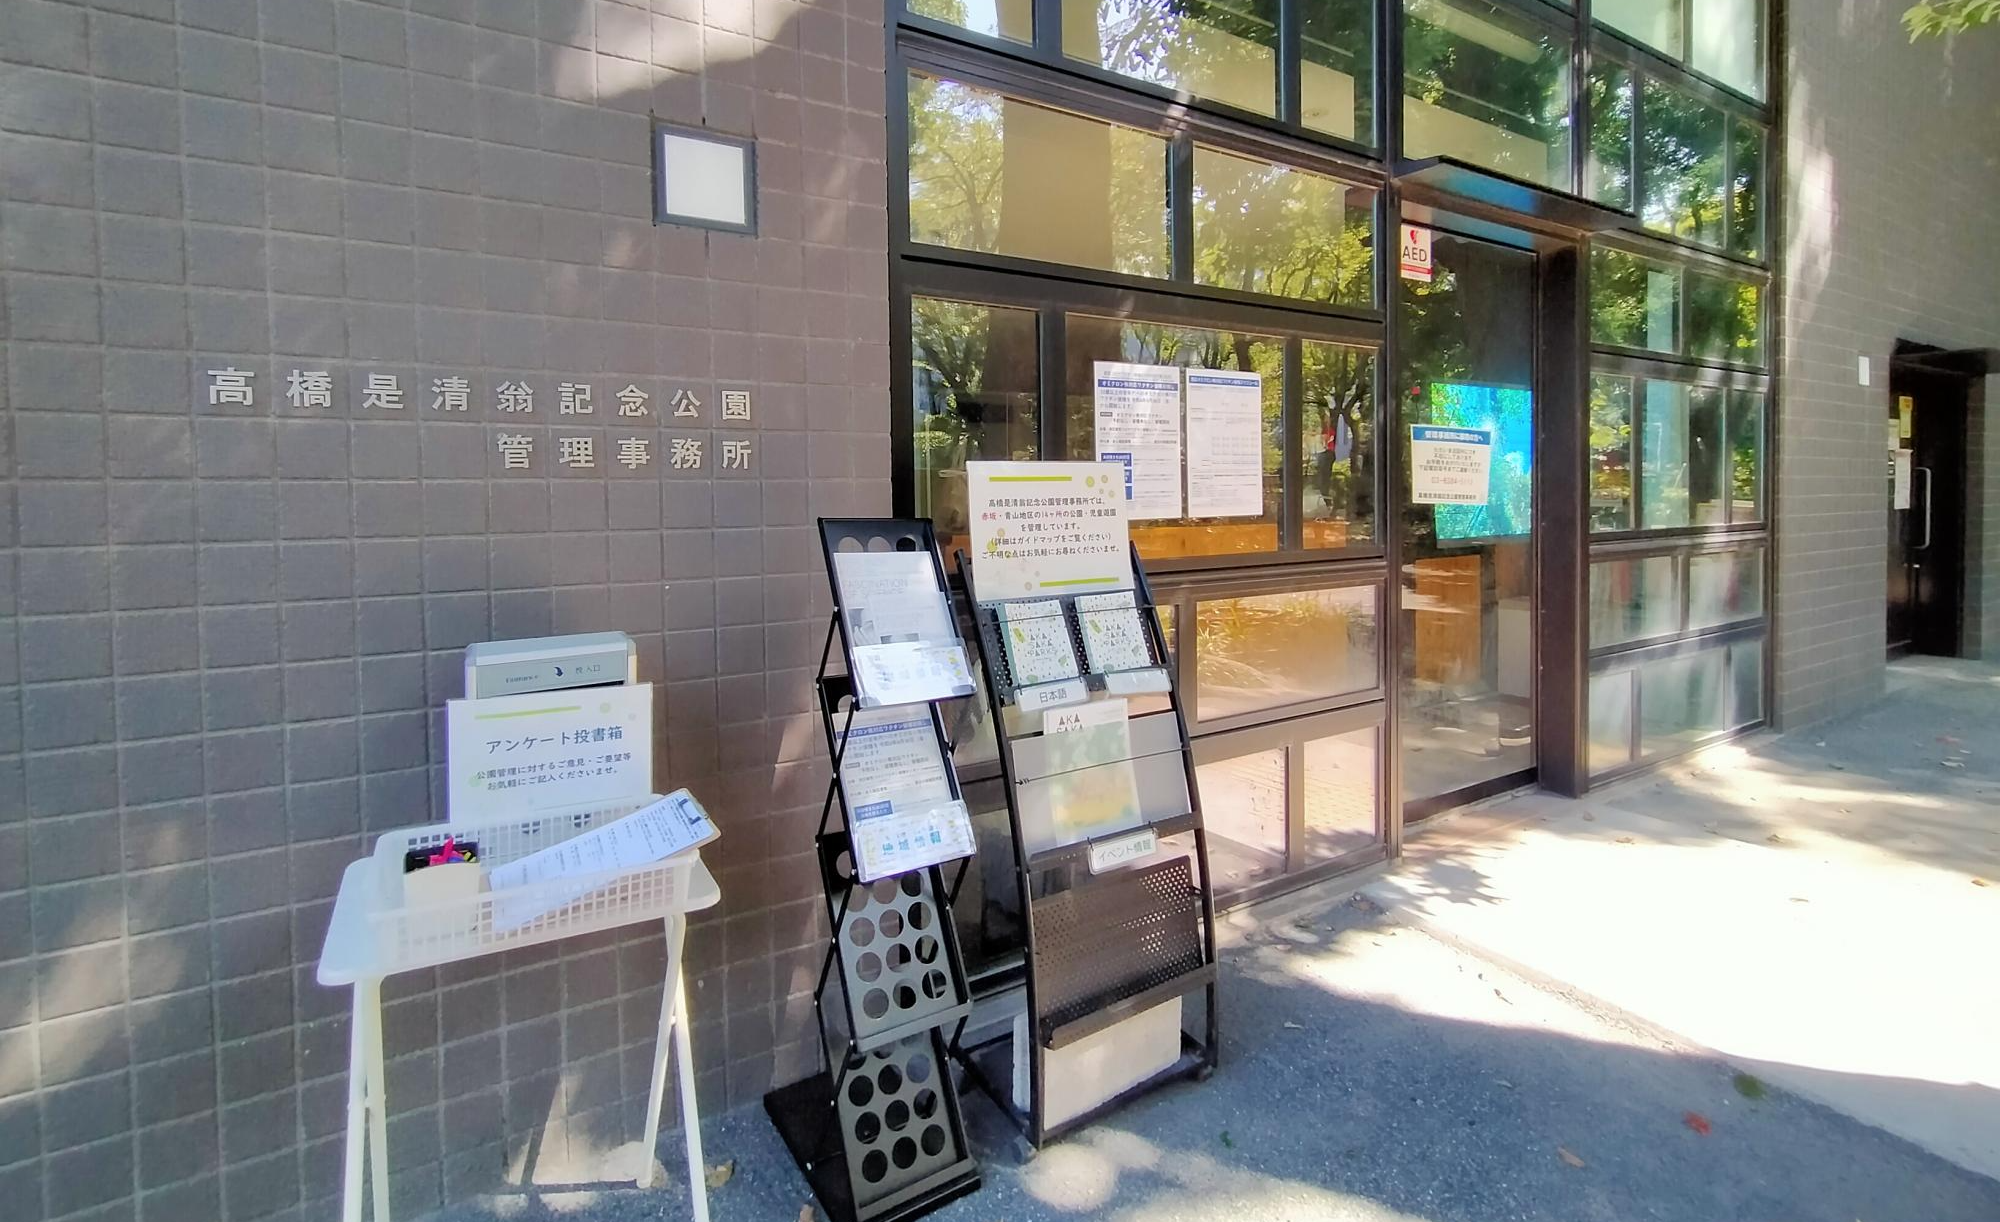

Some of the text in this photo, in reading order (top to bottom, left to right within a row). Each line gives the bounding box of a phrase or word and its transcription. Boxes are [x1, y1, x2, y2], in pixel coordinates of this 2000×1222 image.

[1403, 246, 1427, 262] AED
[207, 366, 752, 421] 高橋是清翁記念公園
[496, 432, 752, 470] 管理事務所
[1021, 522, 1081, 532] を管理しています。
[1039, 688, 1067, 703] 日本語
[1058, 713, 1081, 726] AKA
[486, 726, 623, 755] アンケート投書箱
[476, 752, 632, 780] 公園管理に対するご意見・ご要望等
[487, 767, 618, 791] お気軽にご記入くださいませ。
[1099, 839, 1153, 862] イベント情報
